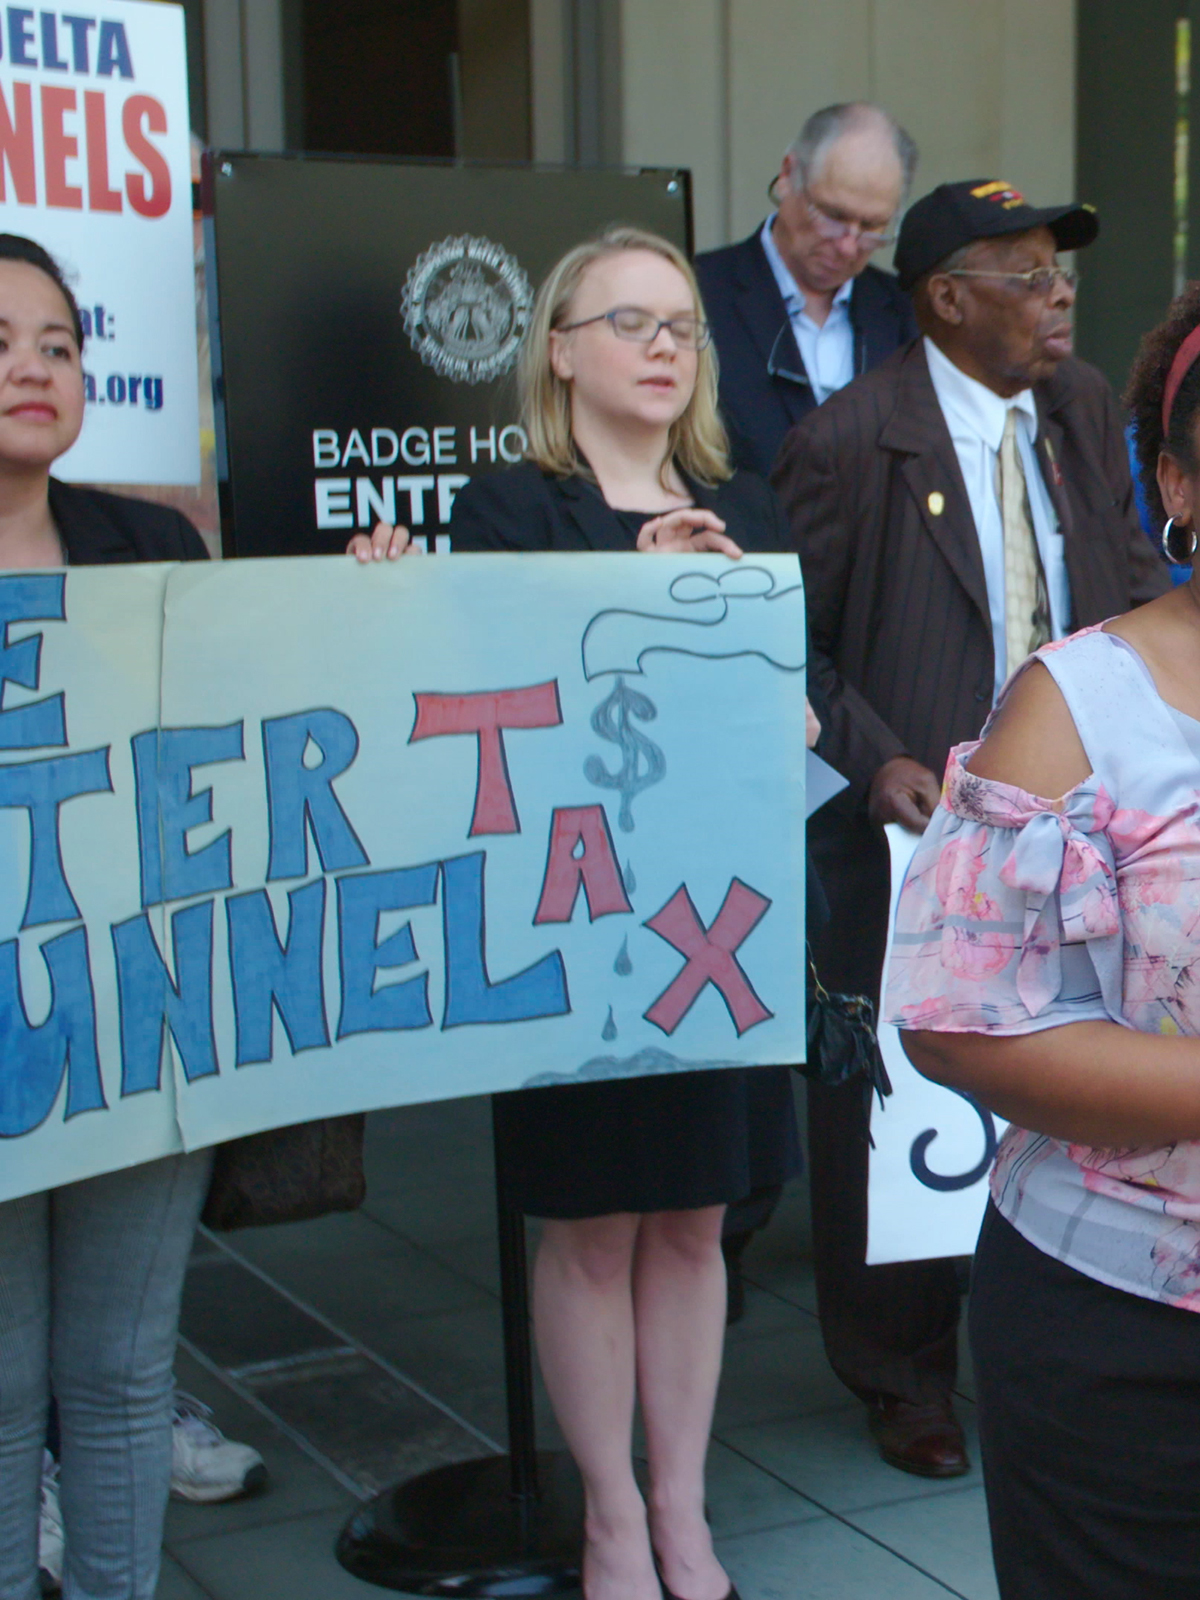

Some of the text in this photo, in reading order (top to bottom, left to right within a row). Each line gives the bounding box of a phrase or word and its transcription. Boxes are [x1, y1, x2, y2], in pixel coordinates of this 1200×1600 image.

[0, 6, 135, 80] ELTA
[0, 80, 173, 219] NELS
[313, 426, 457, 468] BADGE
[0, 707, 371, 933] TER
[408, 678, 776, 1039] TAX
[0, 850, 572, 1138] UNNEL
